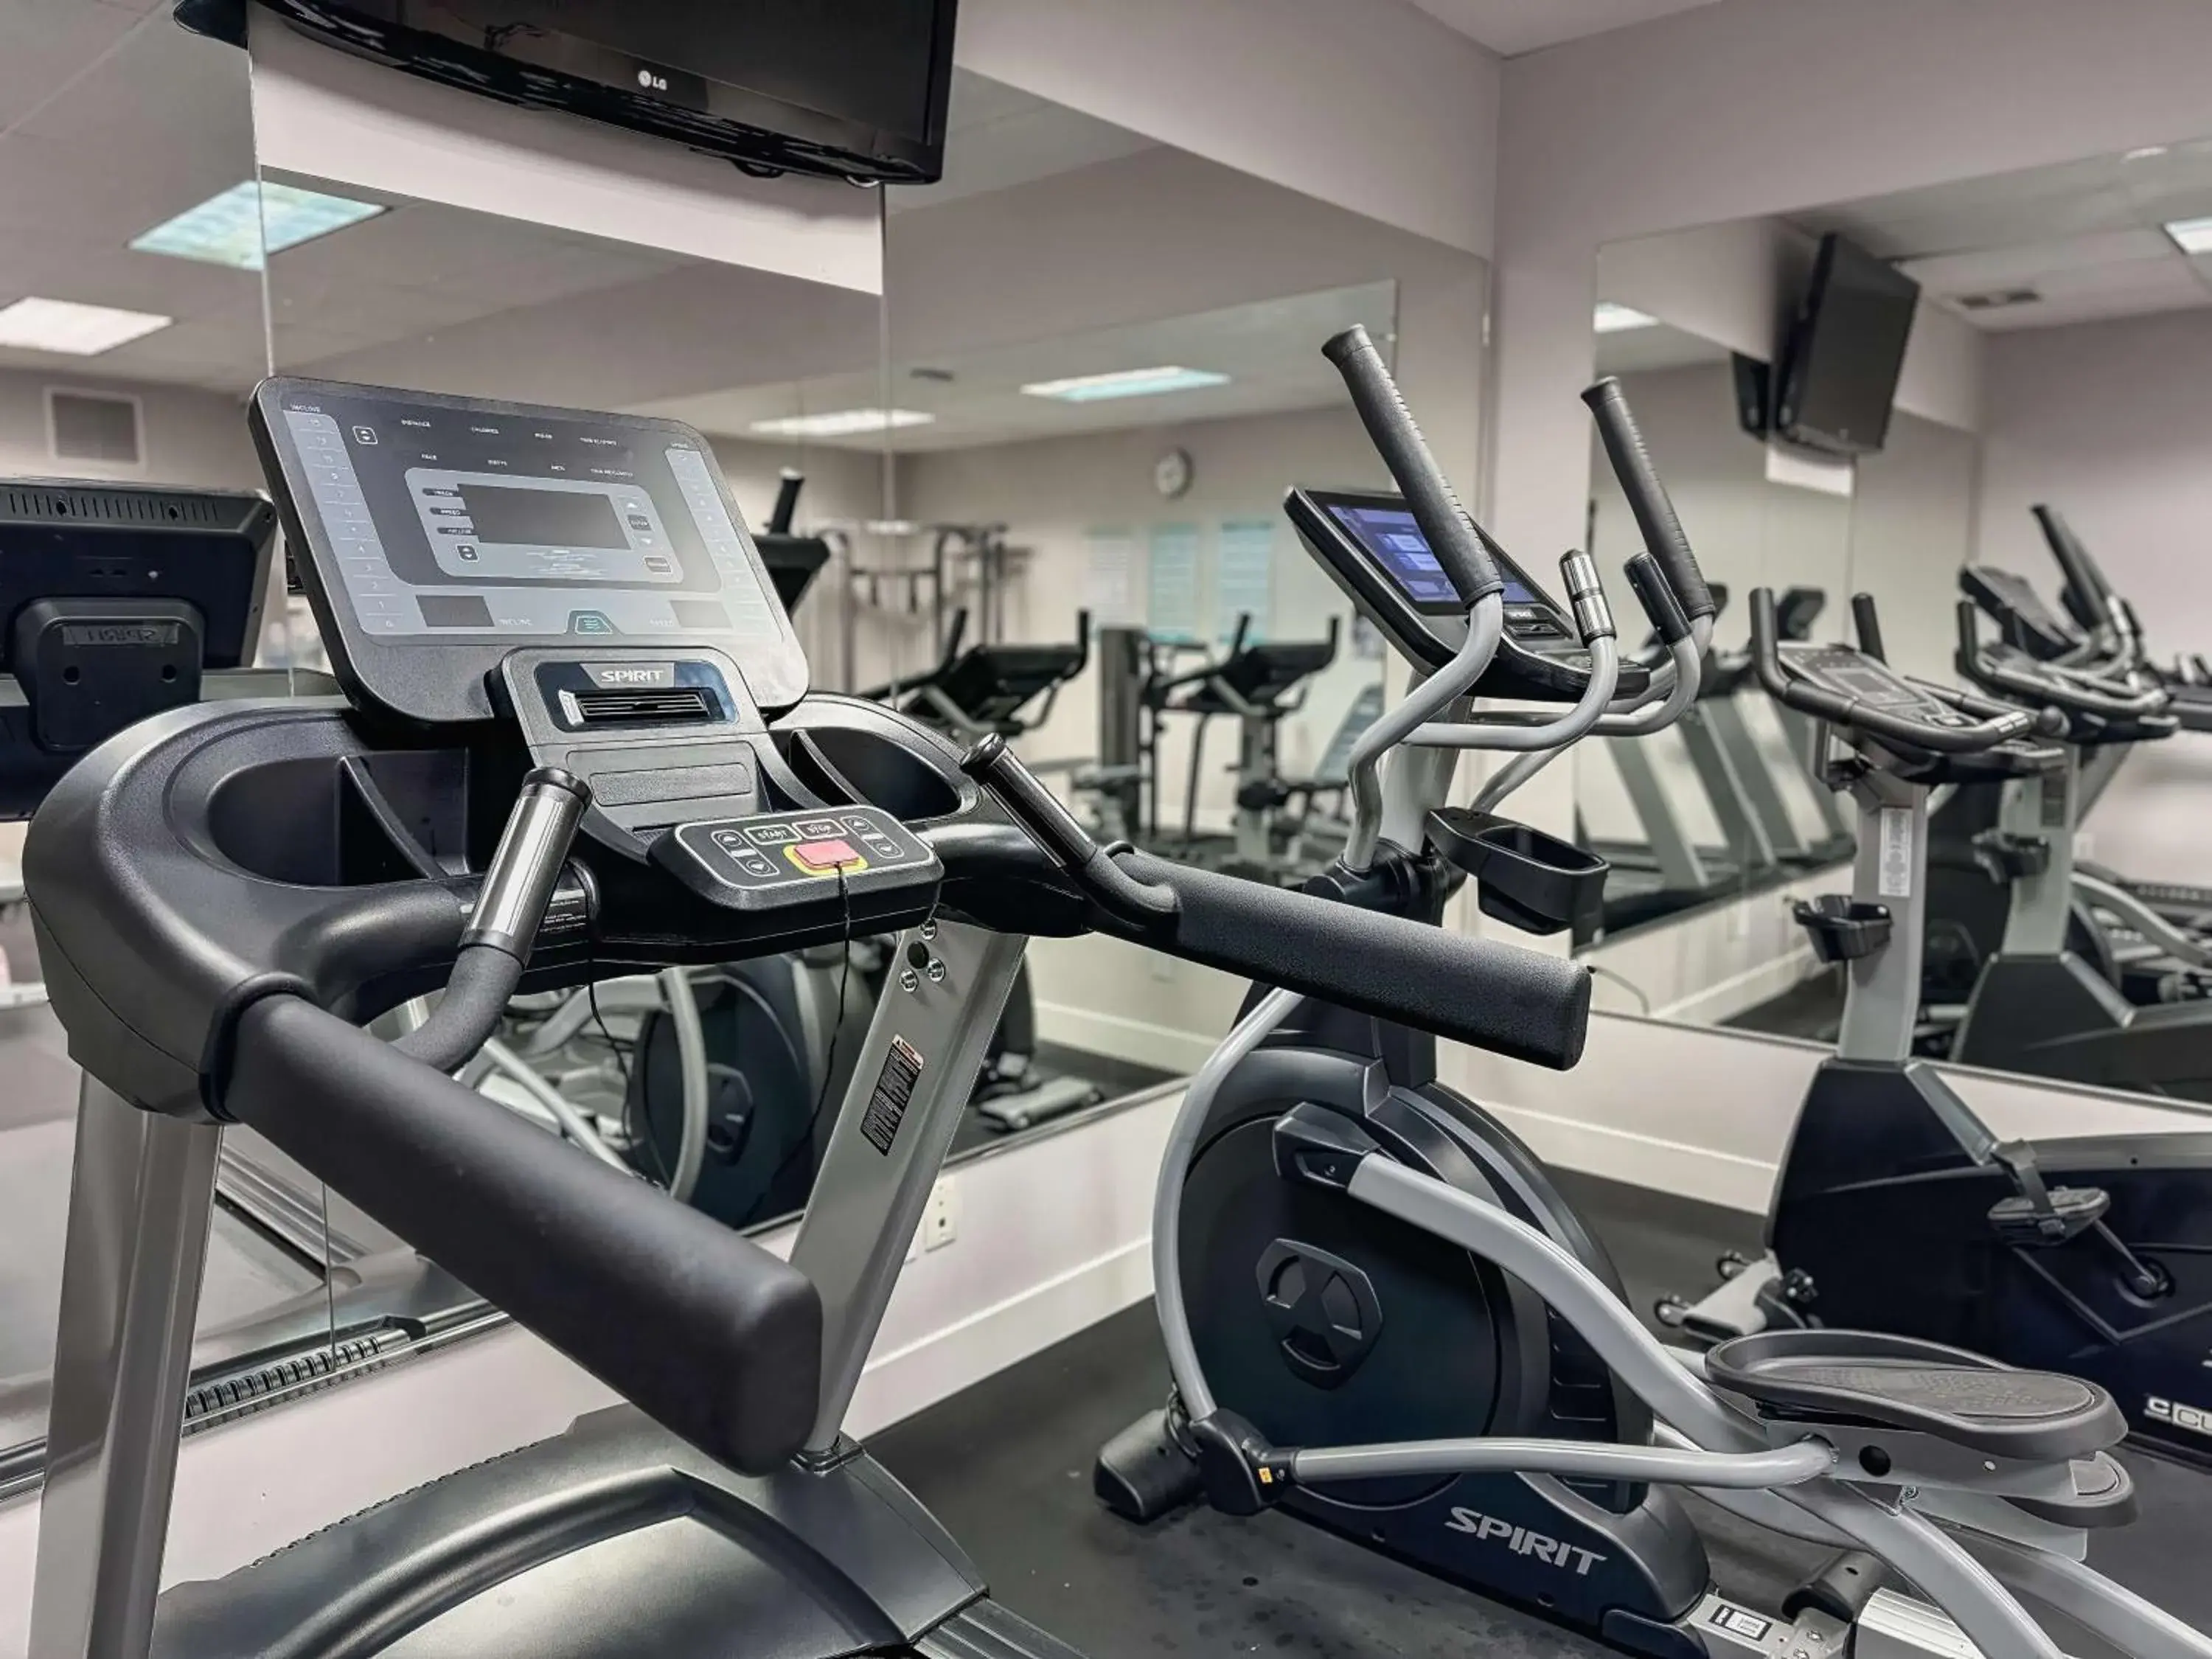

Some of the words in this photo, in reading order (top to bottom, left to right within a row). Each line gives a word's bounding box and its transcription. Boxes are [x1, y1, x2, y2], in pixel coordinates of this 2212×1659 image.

[601, 669, 664, 682] SPIRIT
[757, 830, 788, 839] START
[1444, 1506, 1608, 1576] SPIRIT
